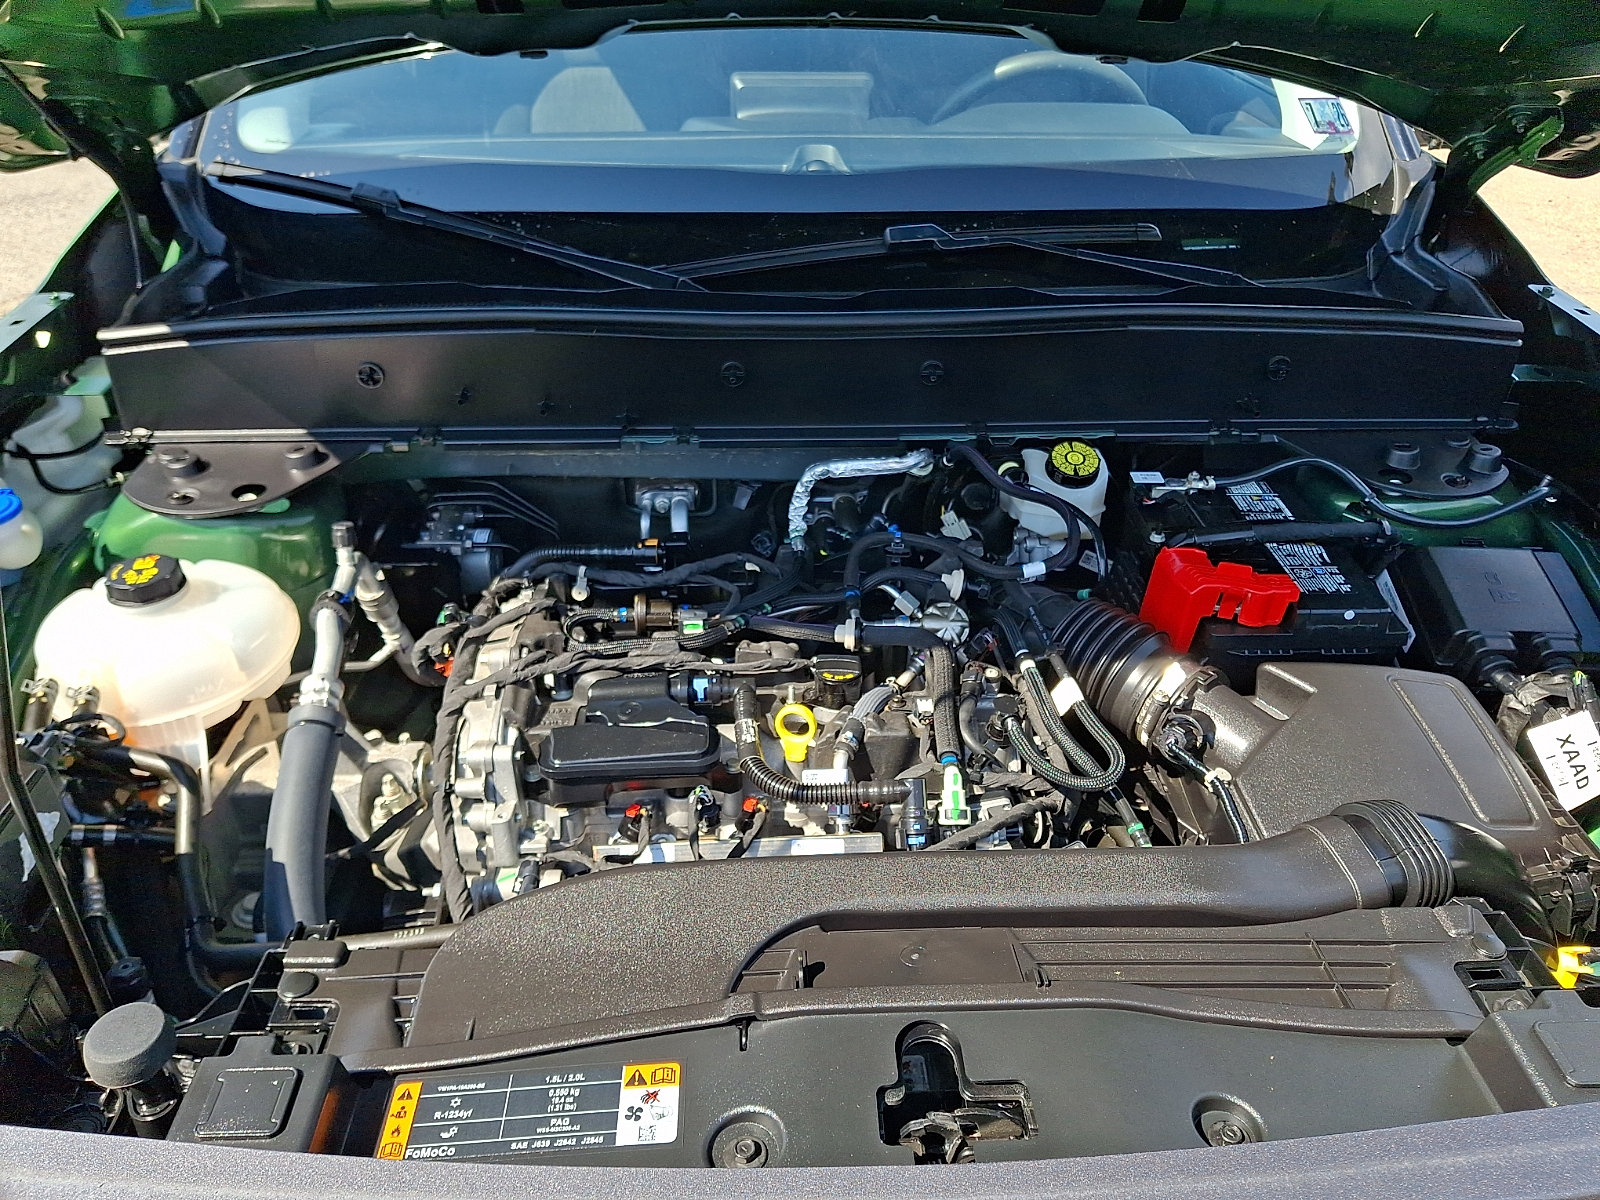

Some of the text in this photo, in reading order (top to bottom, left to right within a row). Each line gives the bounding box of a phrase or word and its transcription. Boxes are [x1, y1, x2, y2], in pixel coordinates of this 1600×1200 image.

[1555, 733, 1590, 790] XAAD
[568, 1073, 586, 1082] 2.0L
[569, 1087, 581, 1097] kg
[433, 1108, 474, 1120] R-1234yf
[550, 1117, 570, 1127] PAG
[510, 1141, 529, 1150] SAE
[404, 1145, 456, 1160] FoMoCo
